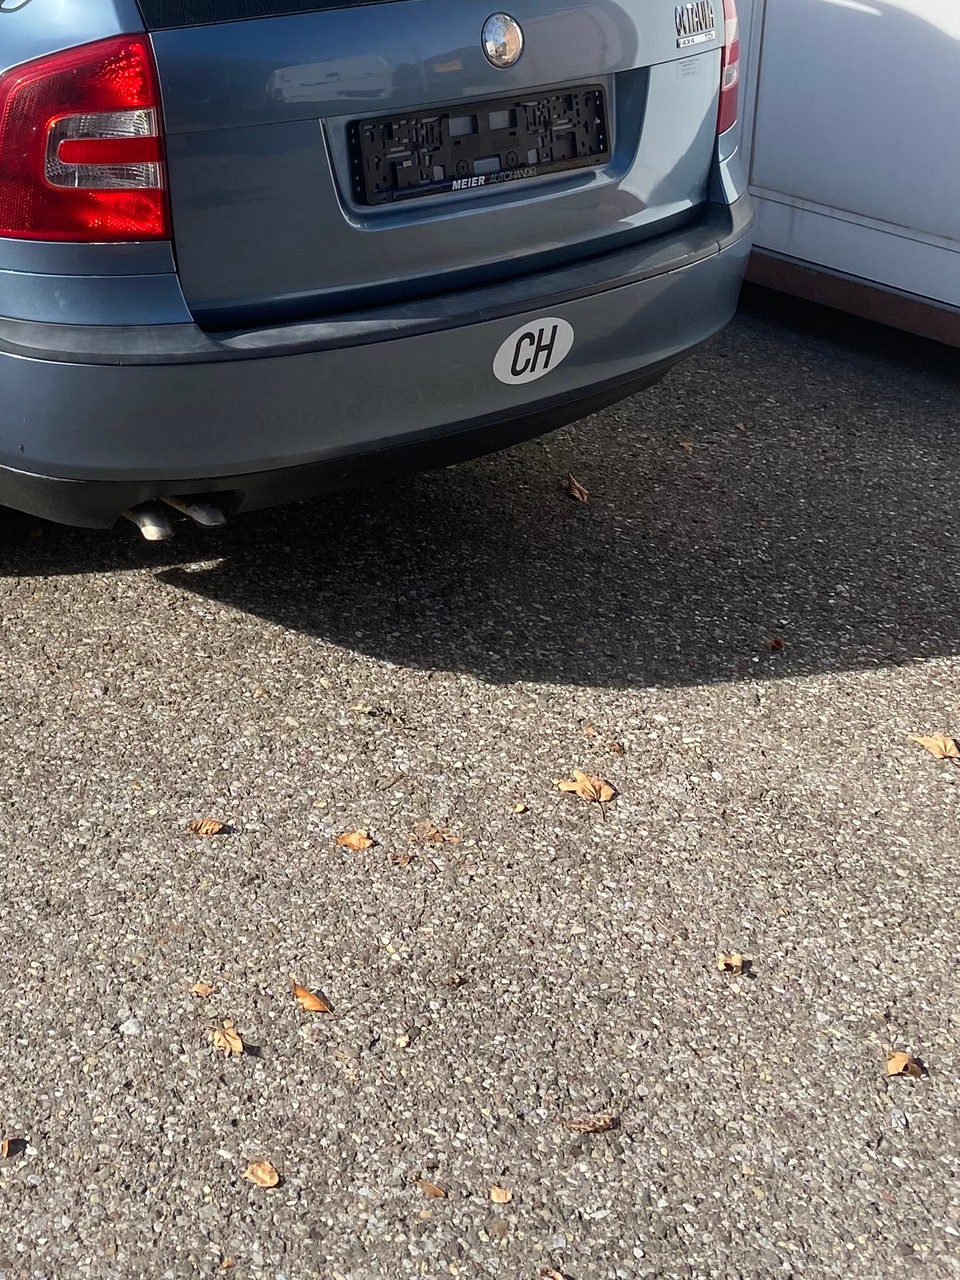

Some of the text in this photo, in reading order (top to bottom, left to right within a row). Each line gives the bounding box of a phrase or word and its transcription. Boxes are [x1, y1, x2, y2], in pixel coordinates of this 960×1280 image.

[452, 166, 538, 190] MEIER AUTOHANDEL
[510, 324, 558, 377] CH
